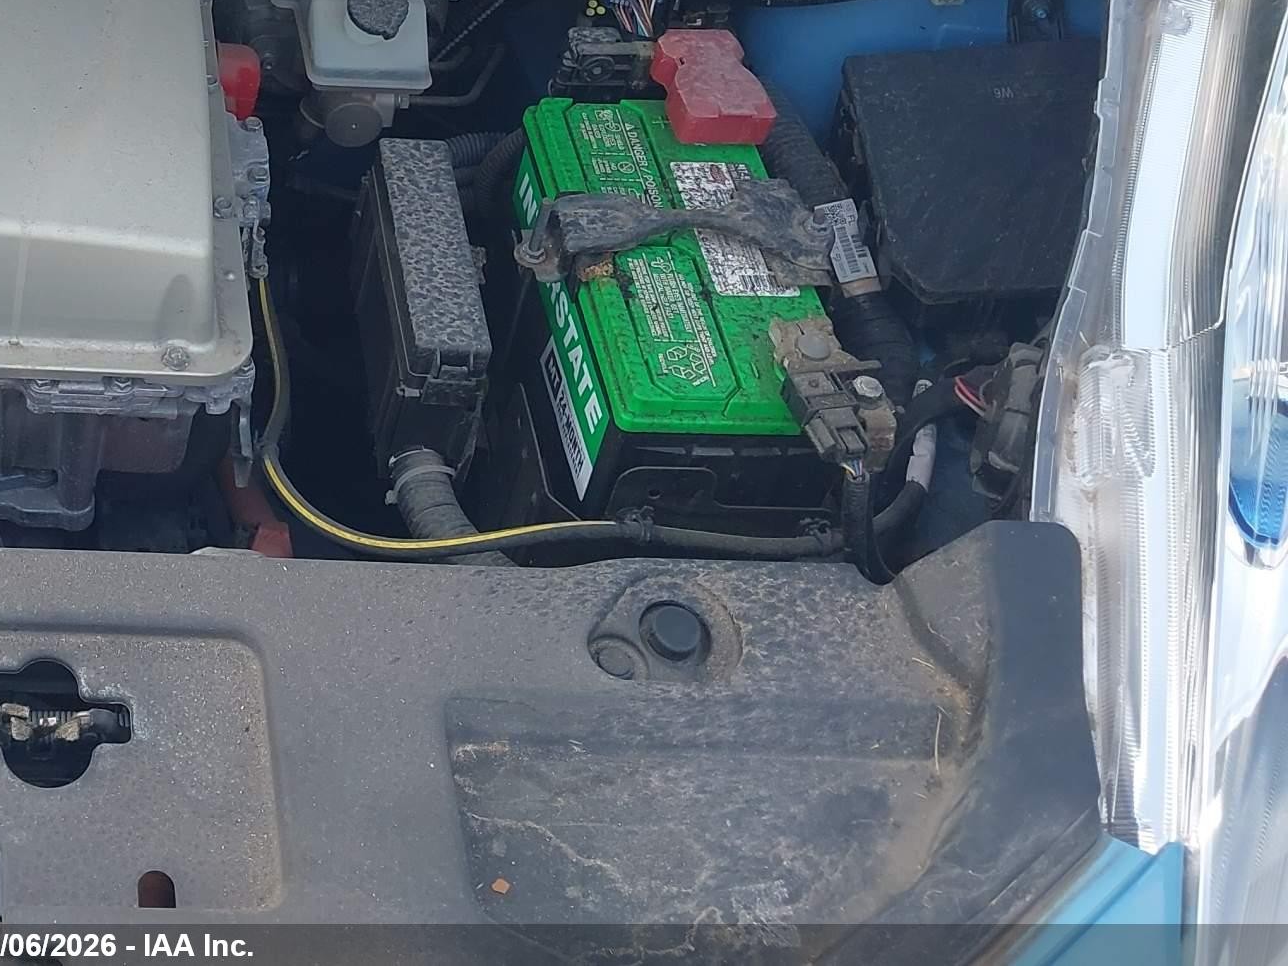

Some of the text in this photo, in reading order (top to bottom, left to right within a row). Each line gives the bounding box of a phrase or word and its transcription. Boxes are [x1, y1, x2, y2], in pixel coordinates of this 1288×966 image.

[627, 131, 649, 167] DANGER
[643, 174, 664, 209] POISON
[548, 356, 560, 389] MT
